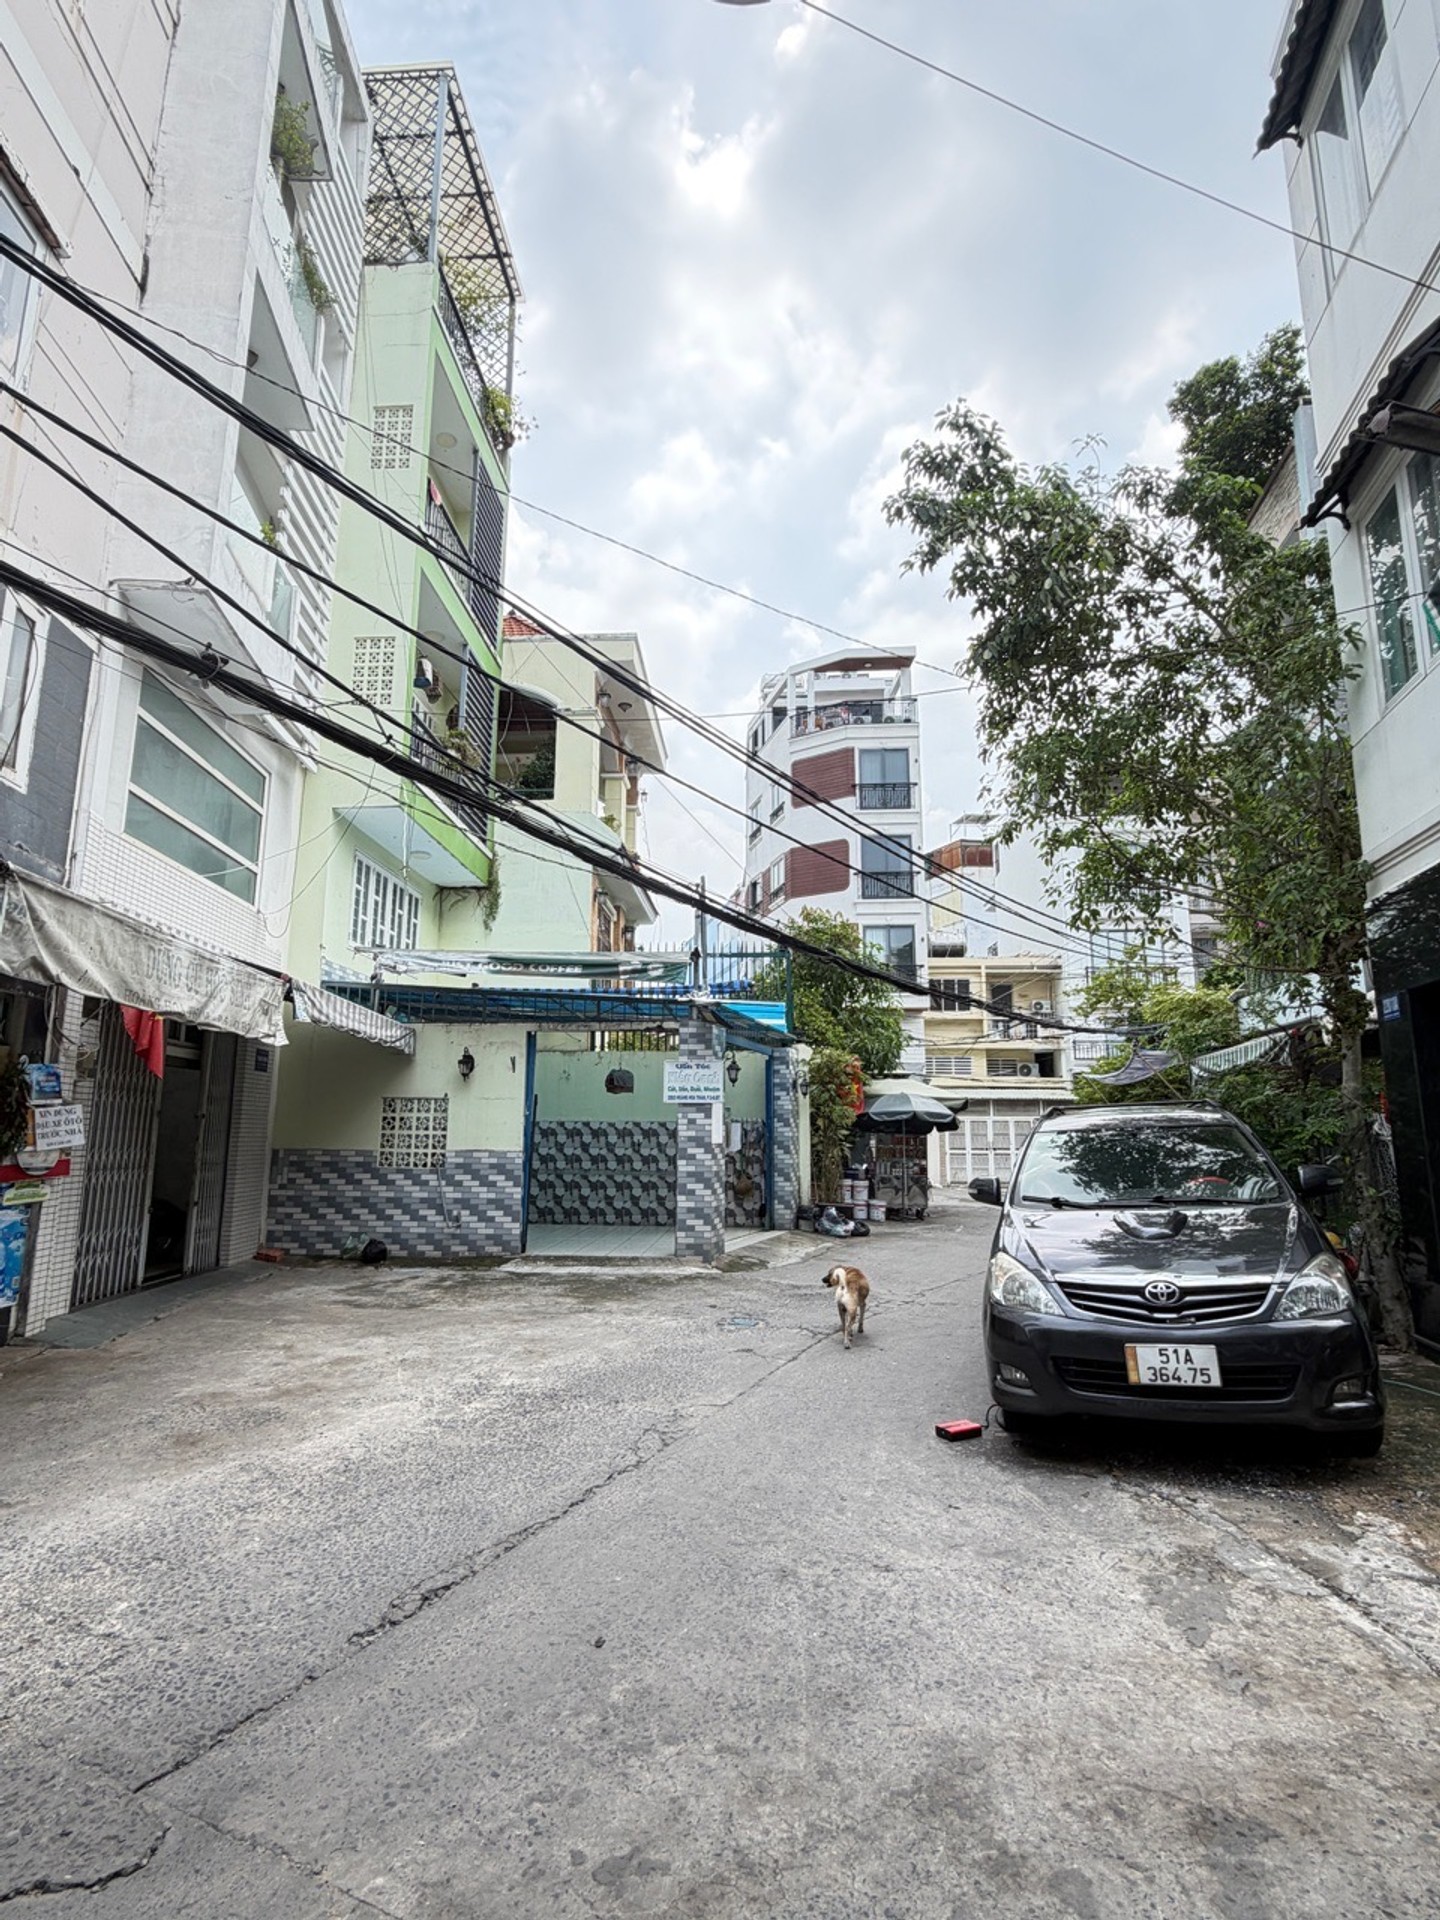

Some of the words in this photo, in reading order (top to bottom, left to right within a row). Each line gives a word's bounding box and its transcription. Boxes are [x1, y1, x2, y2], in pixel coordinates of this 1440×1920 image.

[478, 961, 524, 972] GOOD
[529, 962, 583, 974] COFFEE
[1158, 1348, 1195, 1365] 51A
[1146, 1366, 1212, 1384] 364.75
